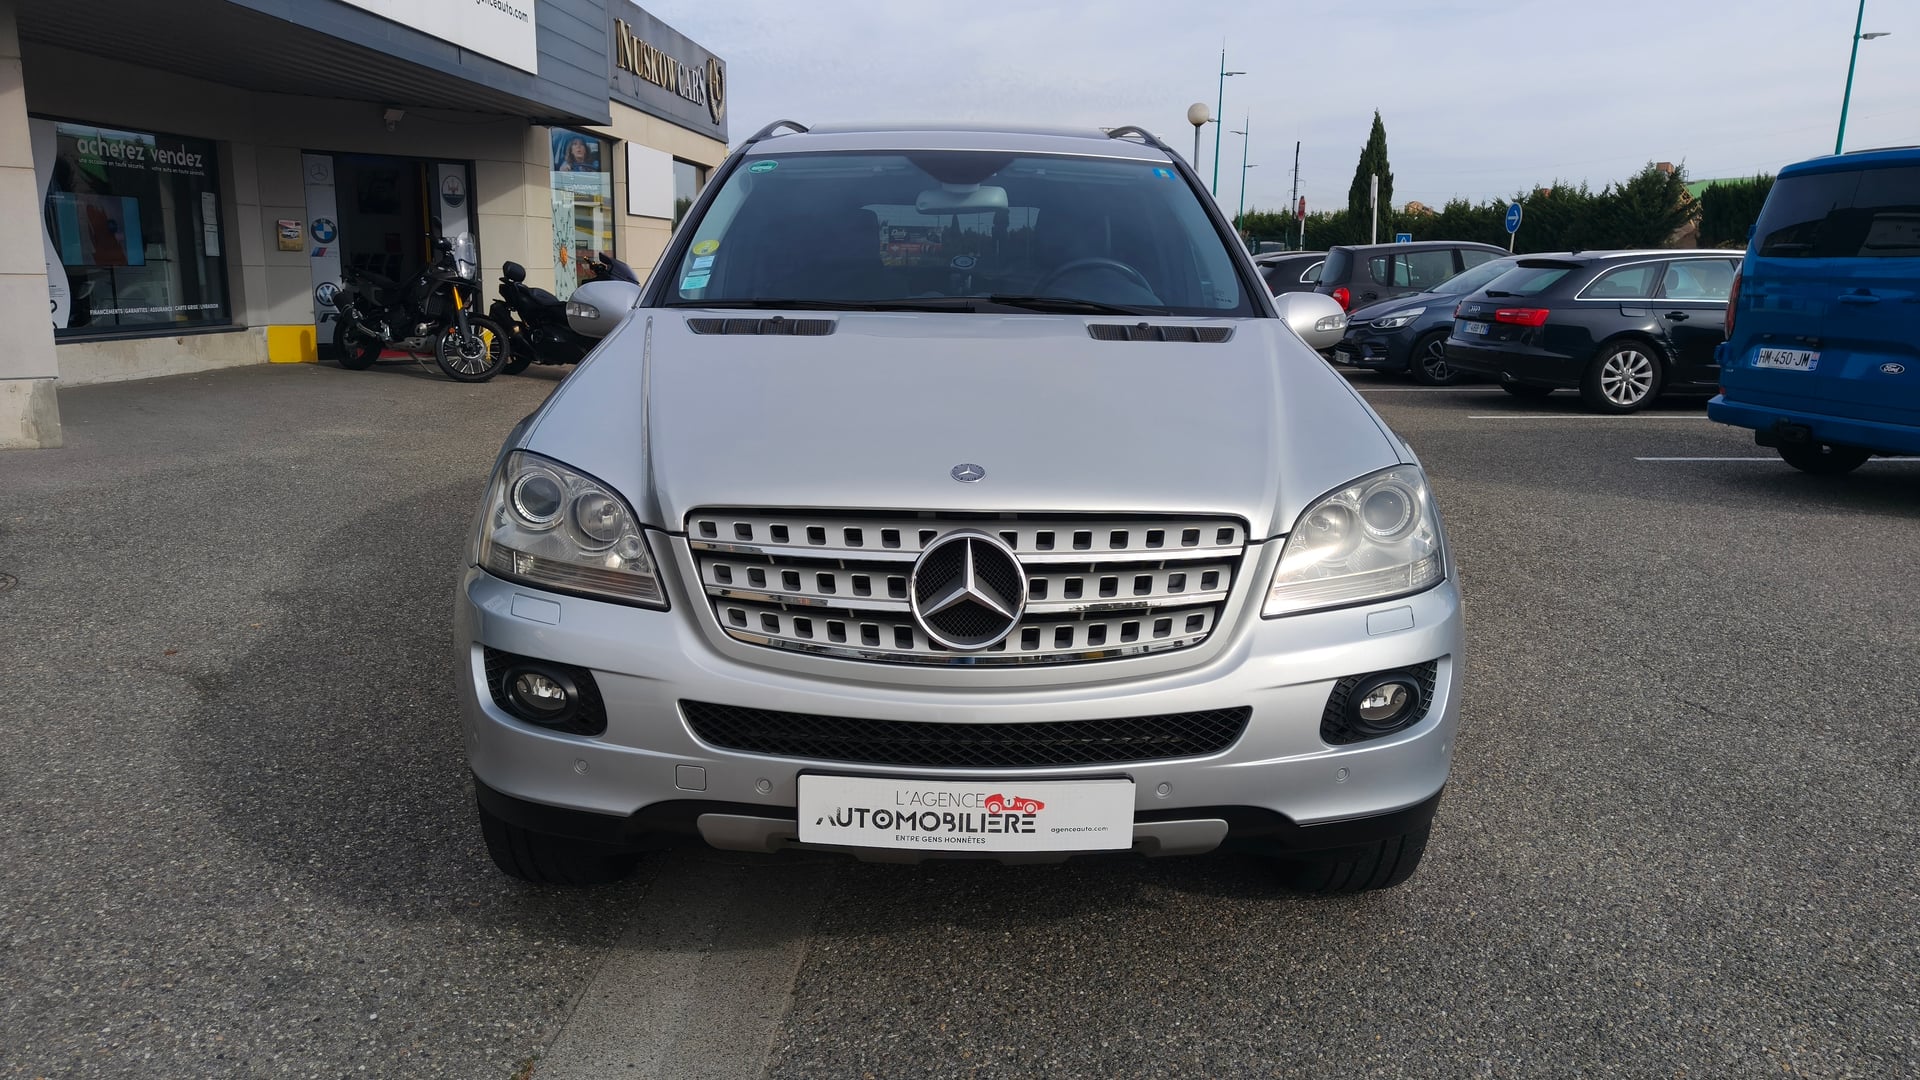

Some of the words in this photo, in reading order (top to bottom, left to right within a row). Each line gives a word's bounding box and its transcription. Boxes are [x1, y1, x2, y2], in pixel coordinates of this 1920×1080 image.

[475, 0, 528, 23] nceauto.com
[677, 62, 706, 105] CARS
[77, 132, 145, 160] achetez
[150, 144, 203, 168] vendez
[896, 790, 985, 808] L'AGENCE
[921, 835, 943, 843] GENS
[944, 835, 986, 844] HONNÊTES
[1050, 826, 1109, 834] agenceauto.com
